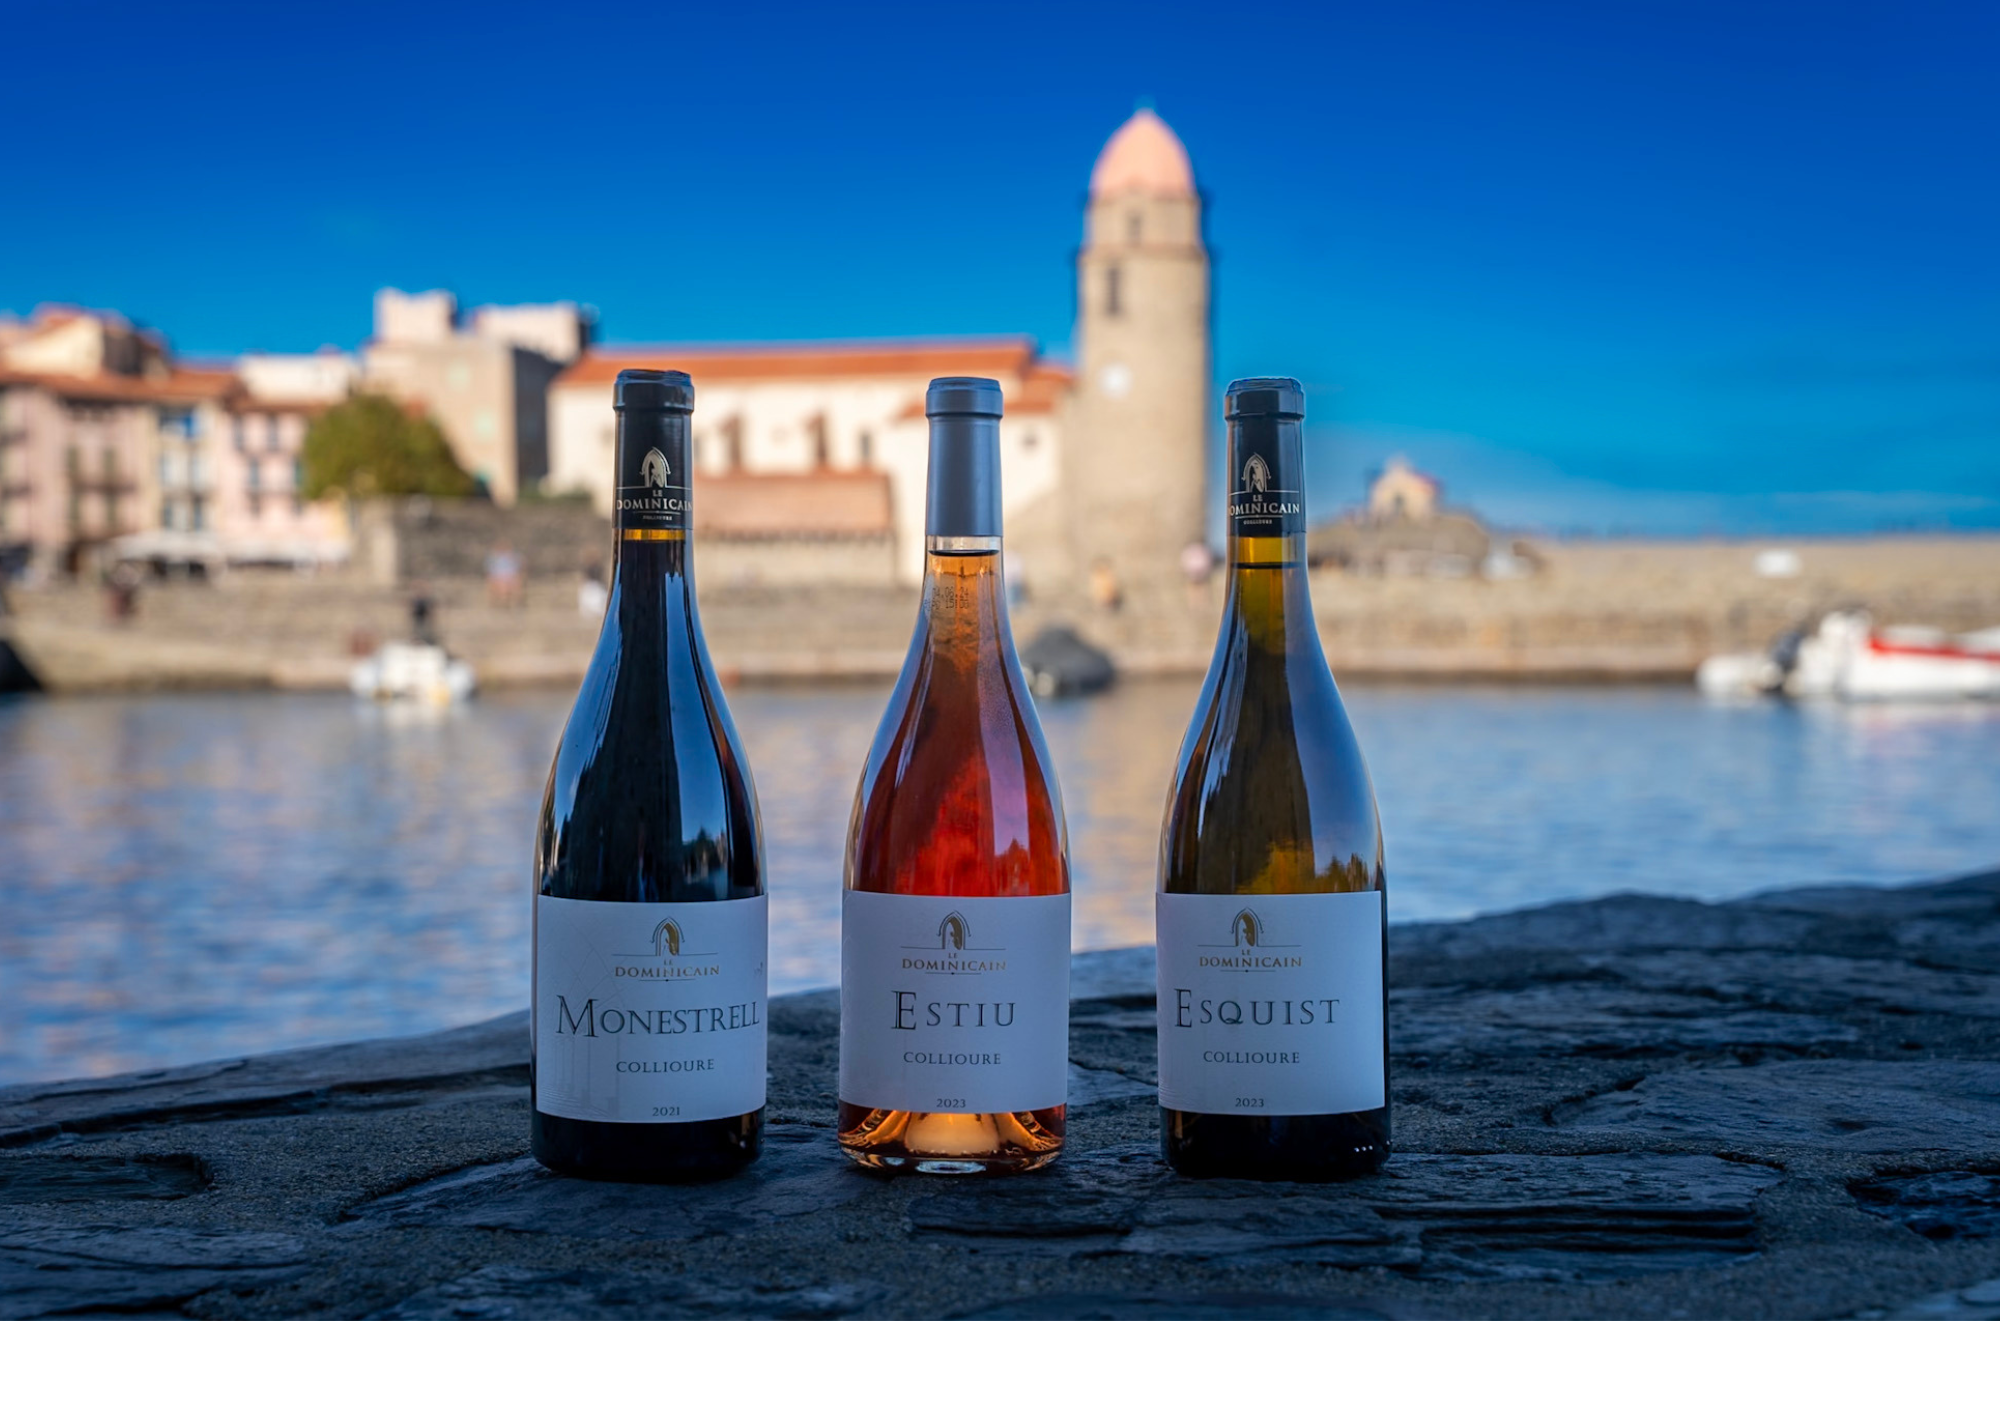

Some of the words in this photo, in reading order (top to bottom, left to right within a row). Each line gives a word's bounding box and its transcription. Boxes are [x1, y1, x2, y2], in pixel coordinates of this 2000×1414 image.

[652, 489, 663, 497] LE
[1252, 494, 1263, 502] LE
[1229, 502, 1300, 517] OMINICAIN
[902, 958, 1007, 971] DOMINICAIN
[1199, 956, 1302, 968] DOMINICAIN
[615, 965, 720, 978] DOMINICAIN
[891, 990, 1016, 1030] ESTIU
[1174, 988, 1340, 1028] ESQUIST
[555, 994, 760, 1038] MONESTRELL
[903, 1051, 1002, 1065] COLLIOURE
[1203, 1050, 1301, 1064] COLLIOURE
[616, 1059, 715, 1073] COLLIOURE
[936, 1098, 966, 1109] 2023
[1234, 1097, 1265, 1108] 2023
[652, 1106, 681, 1117] 2021
